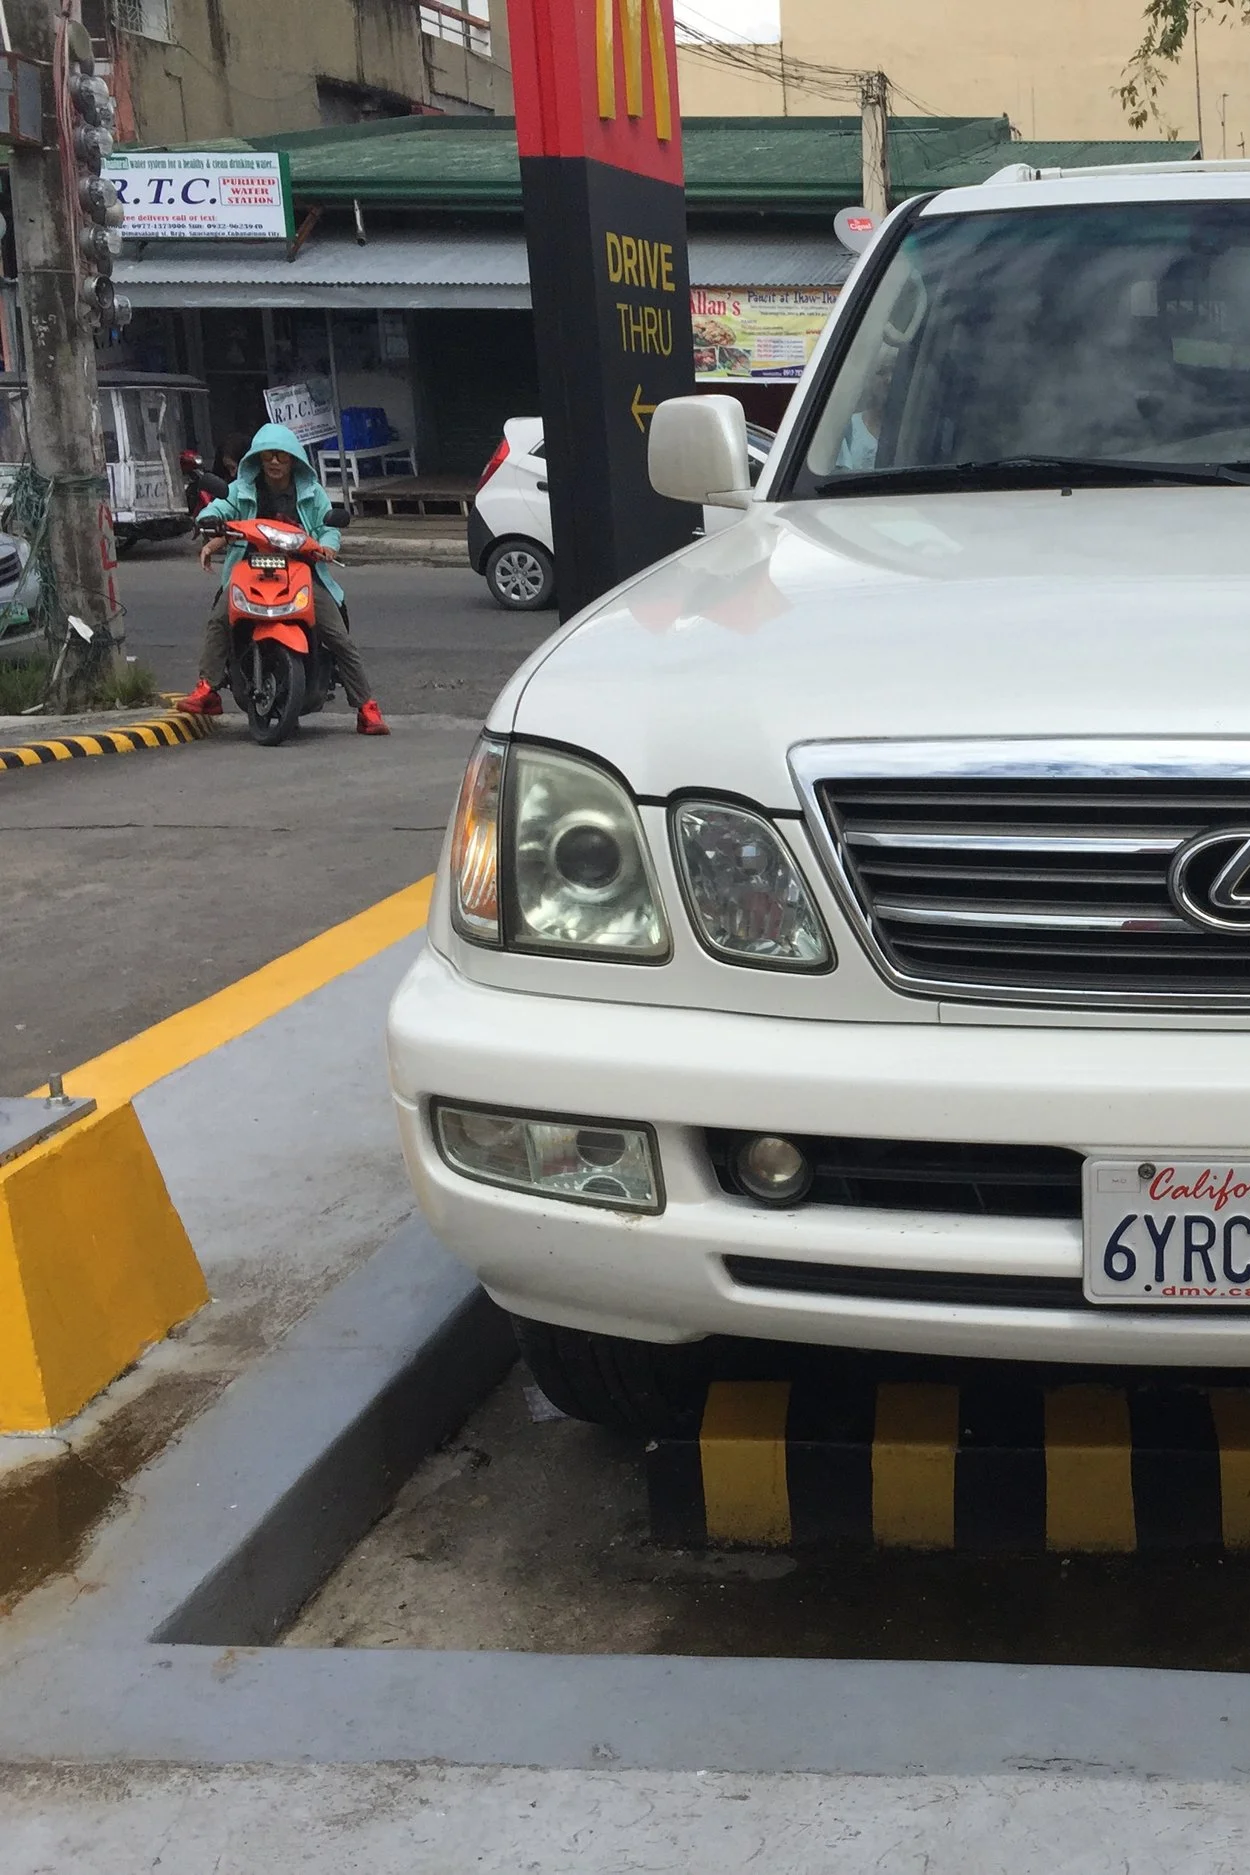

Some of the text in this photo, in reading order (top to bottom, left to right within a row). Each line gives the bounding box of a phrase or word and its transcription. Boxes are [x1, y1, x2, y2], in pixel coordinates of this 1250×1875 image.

[147, 159, 167, 170] system
[212, 159, 228, 169] clean
[229, 158, 255, 170] drinking
[222, 178, 276, 186] PURIFIED
[231, 187, 269, 195] WATER
[137, 214, 169, 223] delivery
[171, 214, 187, 222] call
[605, 231, 676, 292] DRIVE
[747, 290, 776, 303] Pancit
[779, 291, 789, 303] at
[616, 302, 672, 356] THRU
